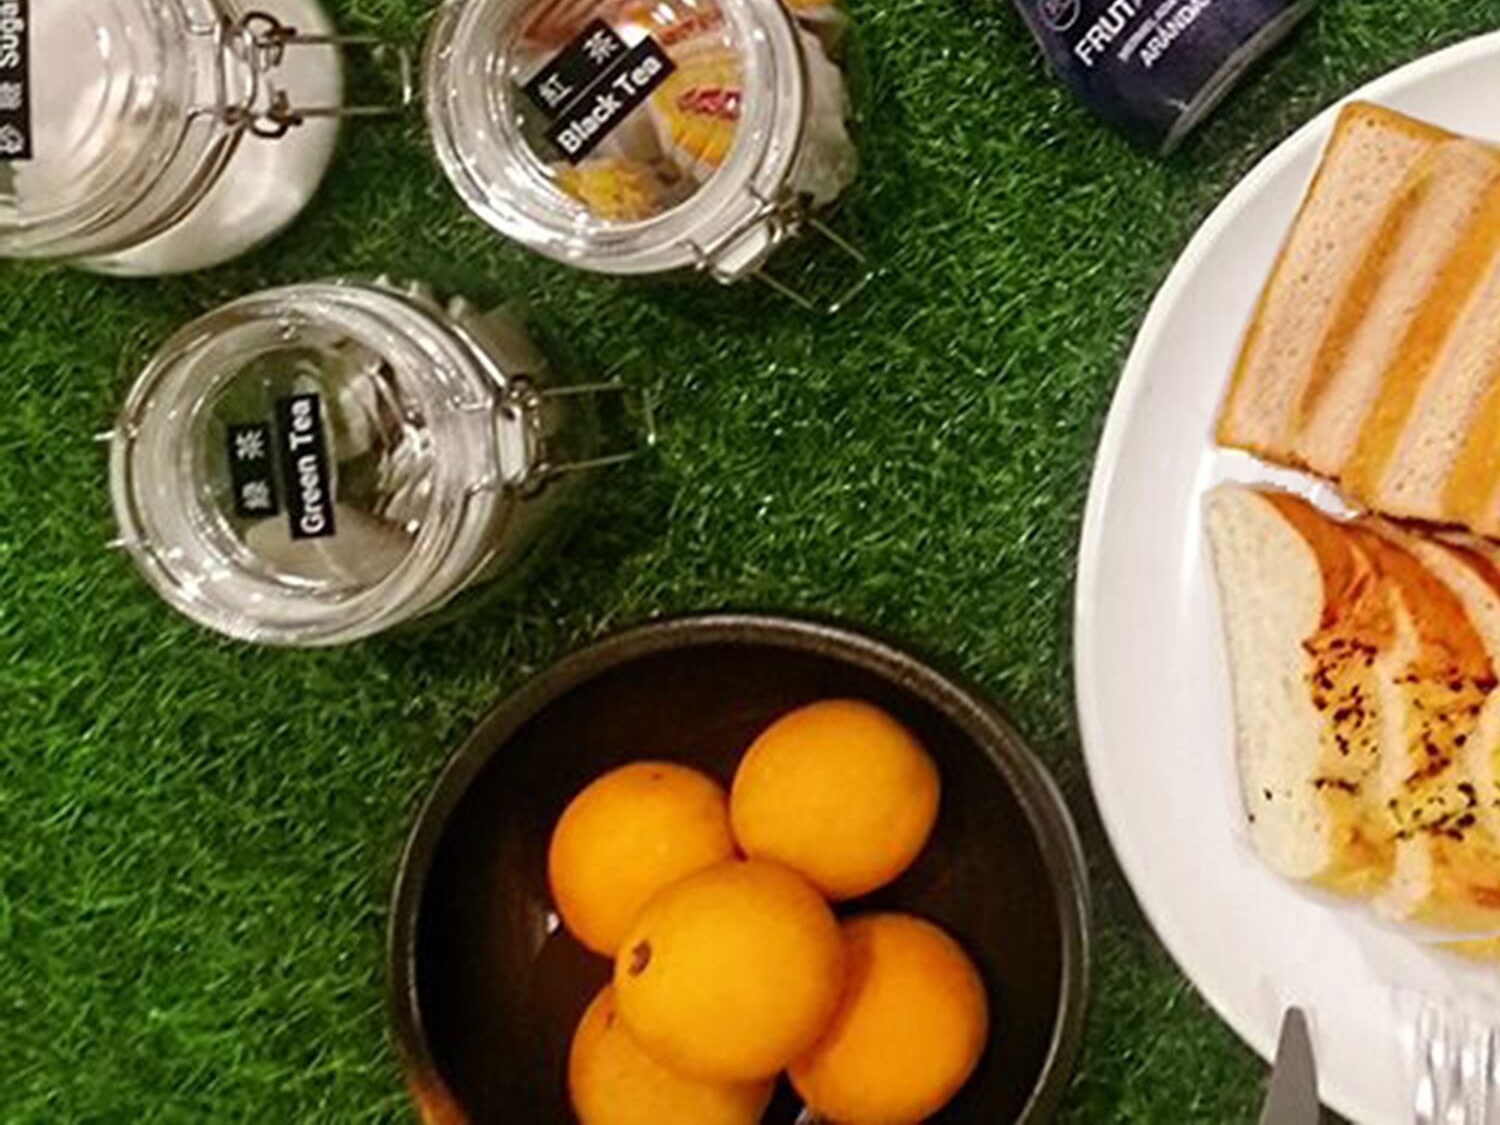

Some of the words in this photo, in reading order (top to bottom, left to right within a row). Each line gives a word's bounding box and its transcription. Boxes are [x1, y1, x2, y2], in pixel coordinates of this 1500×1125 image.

[556, 91, 624, 155] Black
[612, 55, 663, 97] Tea
[289, 398, 315, 452] Tea
[297, 453, 326, 534] Green
